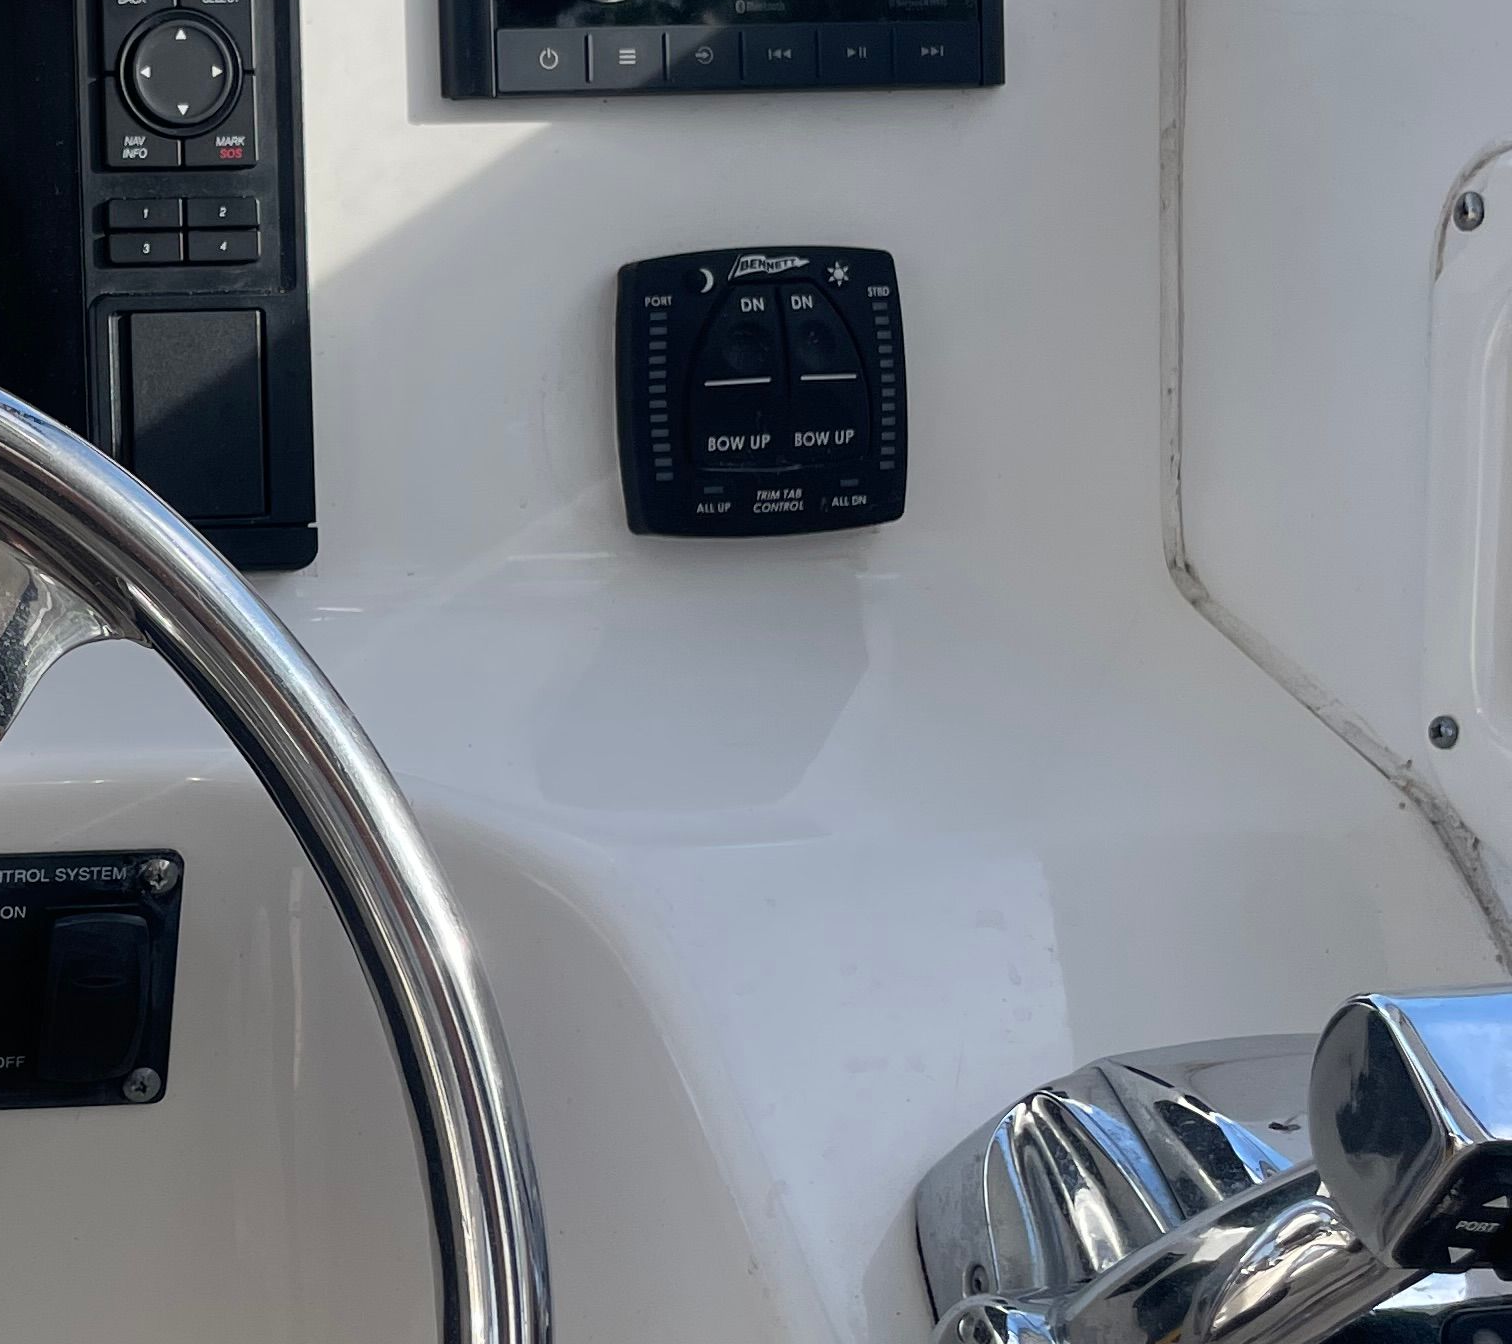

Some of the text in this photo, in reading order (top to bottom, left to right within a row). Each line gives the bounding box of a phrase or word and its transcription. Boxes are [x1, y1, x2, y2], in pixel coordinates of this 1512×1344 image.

[123, 136, 146, 147] NAV
[215, 136, 245, 147] MARK
[122, 148, 148, 159] INFO
[219, 148, 243, 159] SOS
[219, 207, 227, 218] 2
[142, 243, 151, 254] 3
[219, 241, 228, 252] 4
[738, 256, 798, 273] BENNETT
[867, 286, 890, 297] STBD
[645, 296, 672, 307] PORT
[740, 297, 766, 312] DN
[791, 295, 813, 310] DN
[708, 435, 771, 452] BOW UP
[794, 429, 855, 447] BOW UP
[756, 488, 802, 501] TRIM TAB
[753, 500, 804, 513] CONTROL
[831, 495, 867, 507] ALL DN
[697, 502, 731, 513] ALL UP
[55, 867, 126, 882] SYSTEM
[0, 906, 26, 919] ON
[1456, 1220, 1500, 1233] PORT
